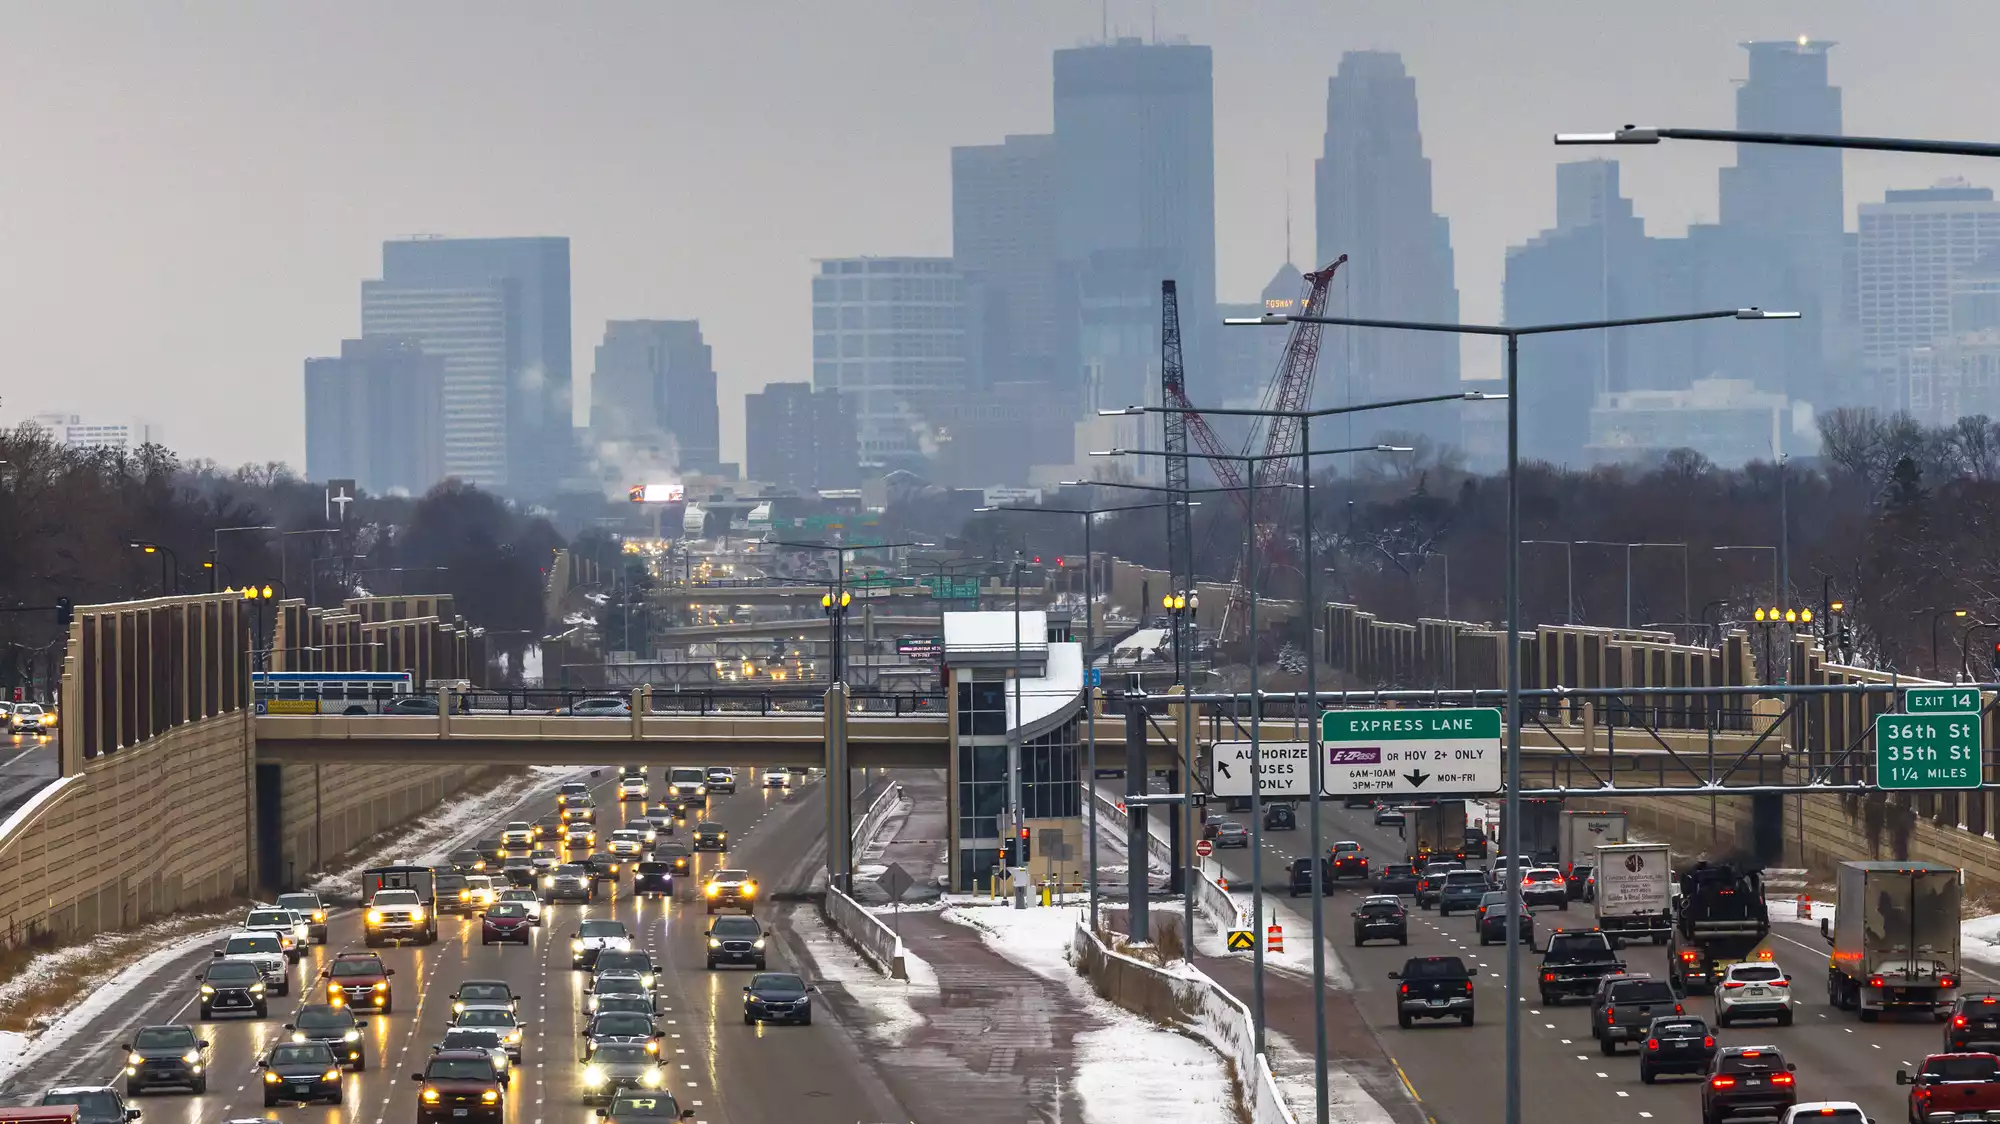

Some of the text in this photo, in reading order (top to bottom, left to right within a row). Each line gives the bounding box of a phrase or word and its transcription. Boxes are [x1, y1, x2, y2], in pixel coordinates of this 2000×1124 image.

[1915, 694, 1971, 708] EXIT 14
[1350, 718, 1473, 732] EXPRESS LANE
[1888, 723, 1970, 739] 36th St
[1387, 752, 1399, 761] OR
[1404, 750, 1427, 761] HOV
[1434, 750, 1448, 760] 2+
[1455, 749, 1484, 760] ONLY
[1888, 745, 1971, 761] 35th St
[1250, 764, 1294, 774] USES
[1927, 768, 1967, 778] MILES
[1349, 769, 1476, 782] 6AM-10AM MON-FRI
[1259, 779, 1294, 789] ONLY
[1352, 781, 1394, 790] 3PM-7PM
